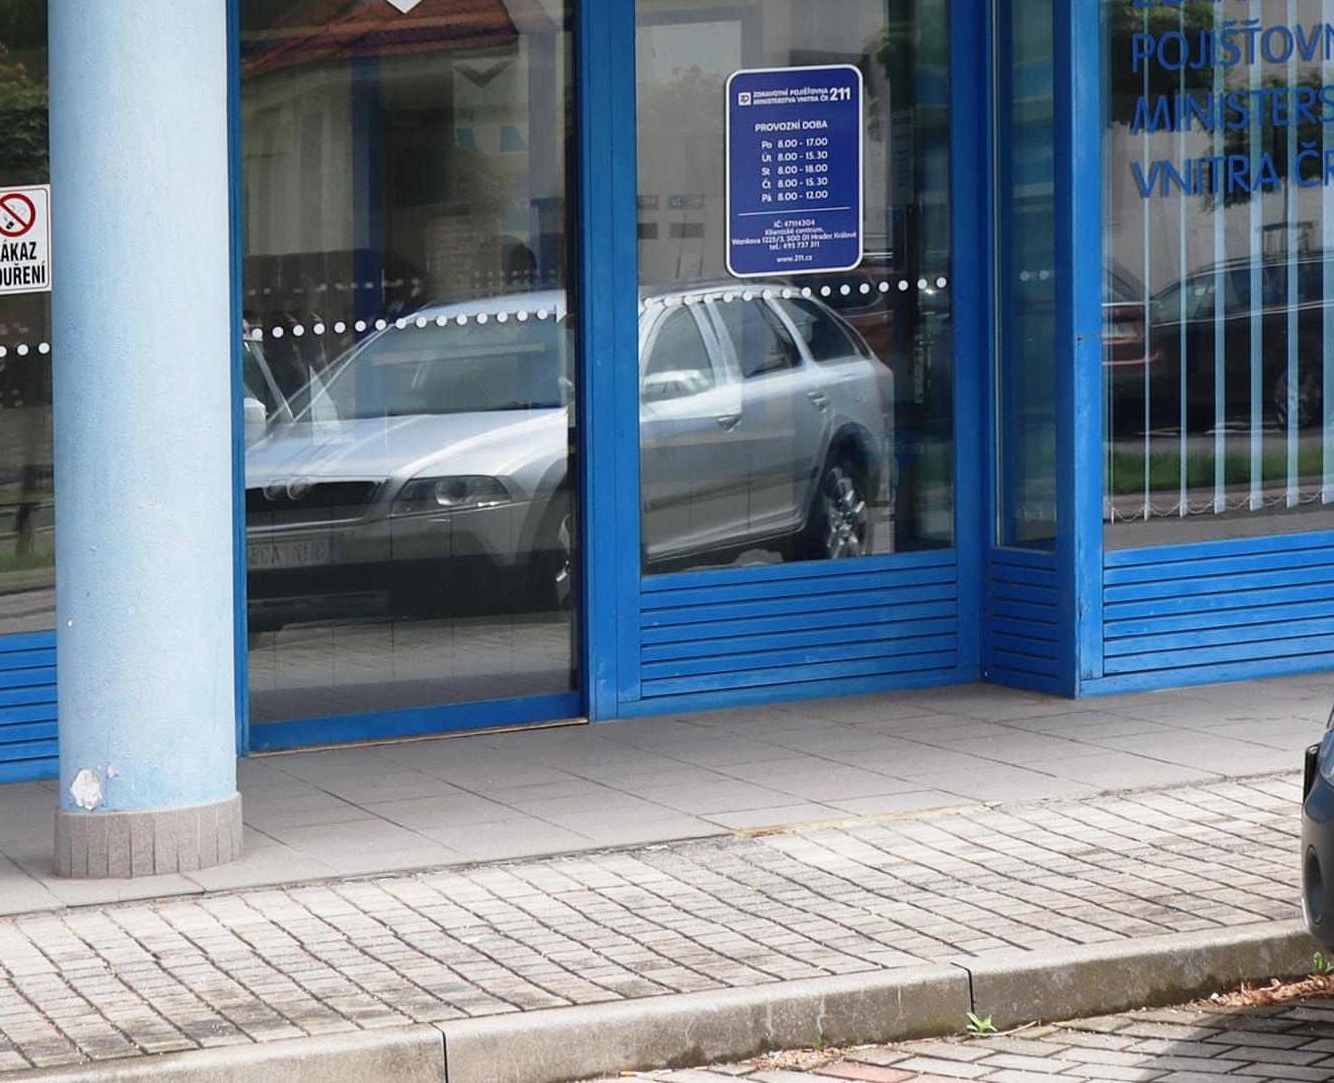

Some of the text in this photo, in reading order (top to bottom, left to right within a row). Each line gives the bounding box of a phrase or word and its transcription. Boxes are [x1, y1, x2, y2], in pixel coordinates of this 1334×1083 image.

[829, 87, 851, 101] 211
[755, 119, 828, 132] PROVOZNÍ DOBA
[762, 140, 772, 150] Po
[777, 139, 798, 148] 8.00
[806, 137, 828, 147] 17.00
[762, 151, 772, 163] Út
[777, 152, 798, 161] 8.00
[762, 167, 770, 176] St
[777, 165, 798, 174] 8.00
[806, 163, 828, 173] 18.00
[1131, 152, 1281, 198] VNITRA
[762, 178, 772, 189] Čt
[777, 179, 798, 188] 8.00
[762, 193, 772, 203] Pá
[777, 192, 798, 201] 8.00
[806, 190, 828, 200] 12.00
[731, 238, 761, 246] Wonkova
[776, 255, 813, 263] www.211.cz
